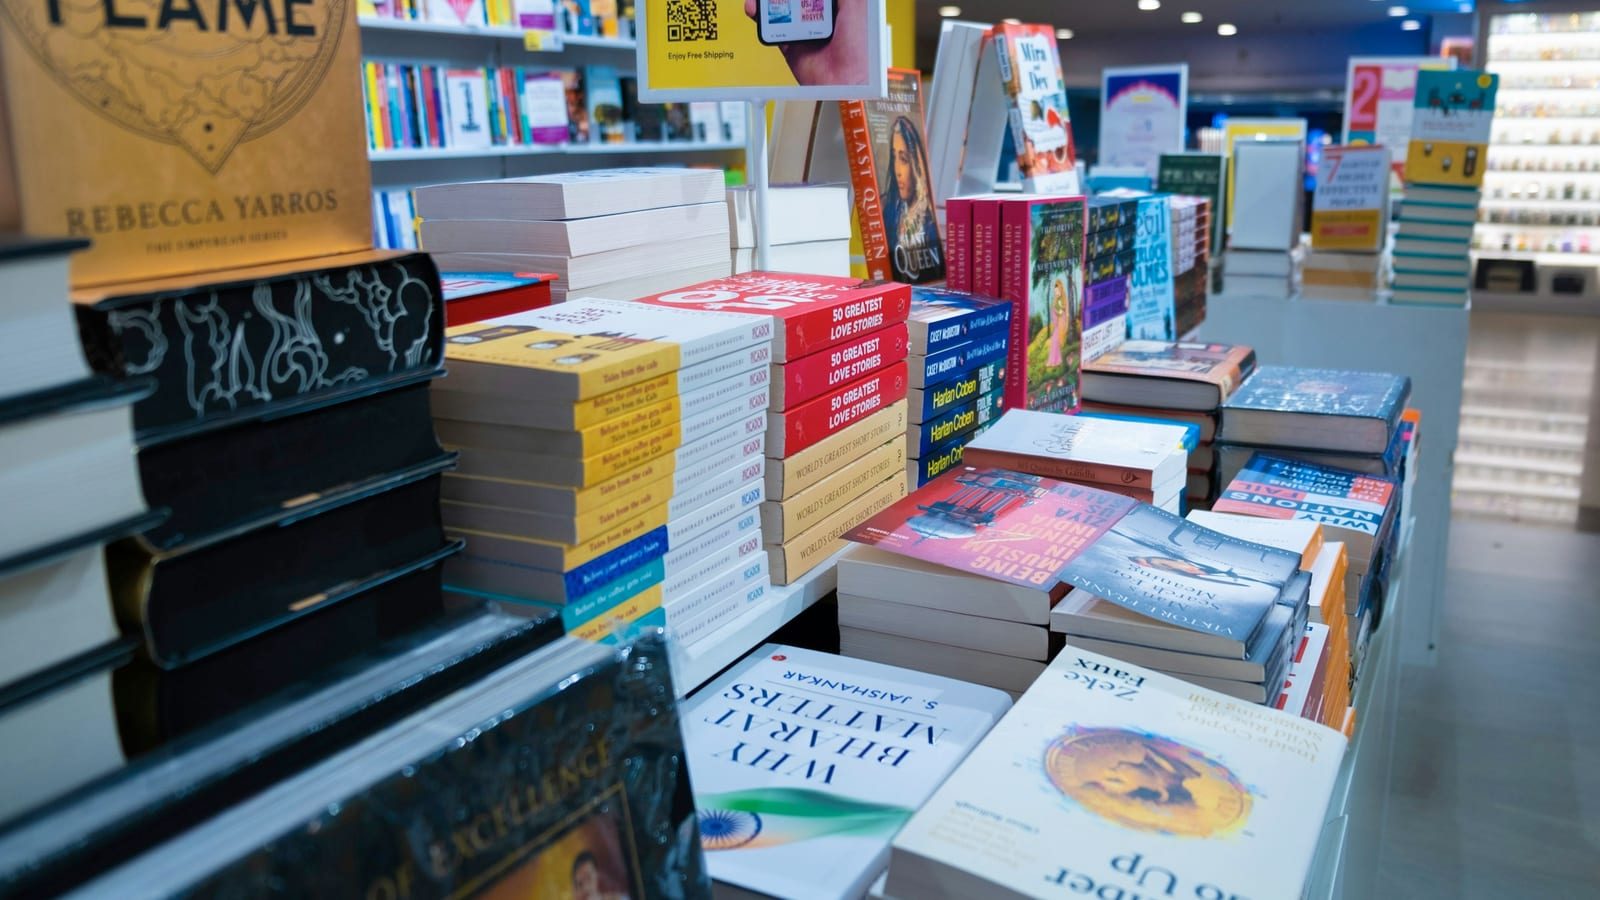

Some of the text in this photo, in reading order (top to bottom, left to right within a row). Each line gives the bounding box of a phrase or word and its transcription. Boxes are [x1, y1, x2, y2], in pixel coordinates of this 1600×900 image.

[668, 51, 734, 61] Enjoy Free Shipping
[1020, 42, 1047, 62] Mira
[1029, 71, 1049, 90] Dev
[1354, 70, 1379, 123] 2
[1325, 155, 1342, 183] 7
[852, 128, 873, 177] LAST
[863, 190, 888, 259] QUEEN
[65, 188, 339, 235] REBECCA YARROS
[948, 223, 956, 262] CHITRA
[975, 224, 983, 263] CHITRA
[1004, 224, 1012, 263] CHITRA
[1013, 224, 1022, 245] THE
[895, 245, 940, 280] QUEEN
[984, 224, 992, 287] THE FOREST
[1013, 249, 1022, 288] FOREST
[1131, 261, 1169, 288] OLMES
[832, 297, 884, 322] 50 GREATEST
[830, 313, 884, 341] LOVE STORIES
[930, 329, 942, 343] CASEY
[603, 373, 620, 384] Tales
[621, 368, 635, 378] from
[636, 365, 645, 373] the
[752, 323, 770, 340] PICADOR
[831, 337, 880, 365] 50 GREATEST
[1011, 302, 1021, 387] ENCHANTMENTS
[829, 355, 881, 385] LOVE STORIES
[926, 363, 939, 377] CASEY
[831, 378, 880, 411] 50 GREATEST
[933, 388, 955, 410] Harlan
[955, 379, 977, 400] Coben
[829, 394, 881, 429] LOVE STORIES
[931, 410, 975, 443] Harlan Coben
[796, 420, 891, 480] WORLD'S GREATEST SHORT STORIES
[927, 445, 964, 479] Harlan Cob
[1064, 467, 1096, 480] Gandhi
[1269, 463, 1346, 482] POVERTY
[1269, 479, 1341, 497] ORIGINS
[796, 458, 890, 521] WORLD'S GREATEST SHORT STORIES
[1243, 483, 1300, 499] FAIL
[599, 512, 616, 524] Tales
[616, 506, 630, 517] from
[630, 500, 640, 509] the
[1054, 507, 1108, 525] ZIYA
[1229, 491, 1373, 522] NATIONS
[1300, 513, 1369, 531] WHY
[589, 541, 606, 552] Tales
[606, 532, 621, 543] from
[622, 527, 632, 536] the
[800, 537, 828, 560] WORLD'S
[828, 520, 854, 543] GREATEST
[855, 504, 873, 523] SHORT
[873, 492, 893, 512] STORIES
[1015, 527, 1087, 549] HINDU
[1031, 513, 1097, 537] INDIA
[960, 540, 1062, 573] MUSLIM
[1047, 544, 1076, 561] IN
[969, 556, 1051, 585] BEING
[1127, 563, 1217, 600] Meaning
[596, 595, 607, 604] the
[1071, 574, 1145, 611] FRANKL
[1112, 569, 1221, 611] Search For
[1160, 608, 1233, 635] VIKTOR
[1063, 671, 1140, 701] Zeke
[1075, 656, 1148, 687] Faux
[782, 670, 939, 711] S. JAISHANKAR
[1187, 692, 1221, 708] Fall
[722, 682, 951, 746] MATTERS
[703, 707, 911, 769] BHARAT
[711, 741, 836, 785] WHY
[428, 739, 610, 877] EXCELLENCE
[1109, 854, 1179, 897] Up
